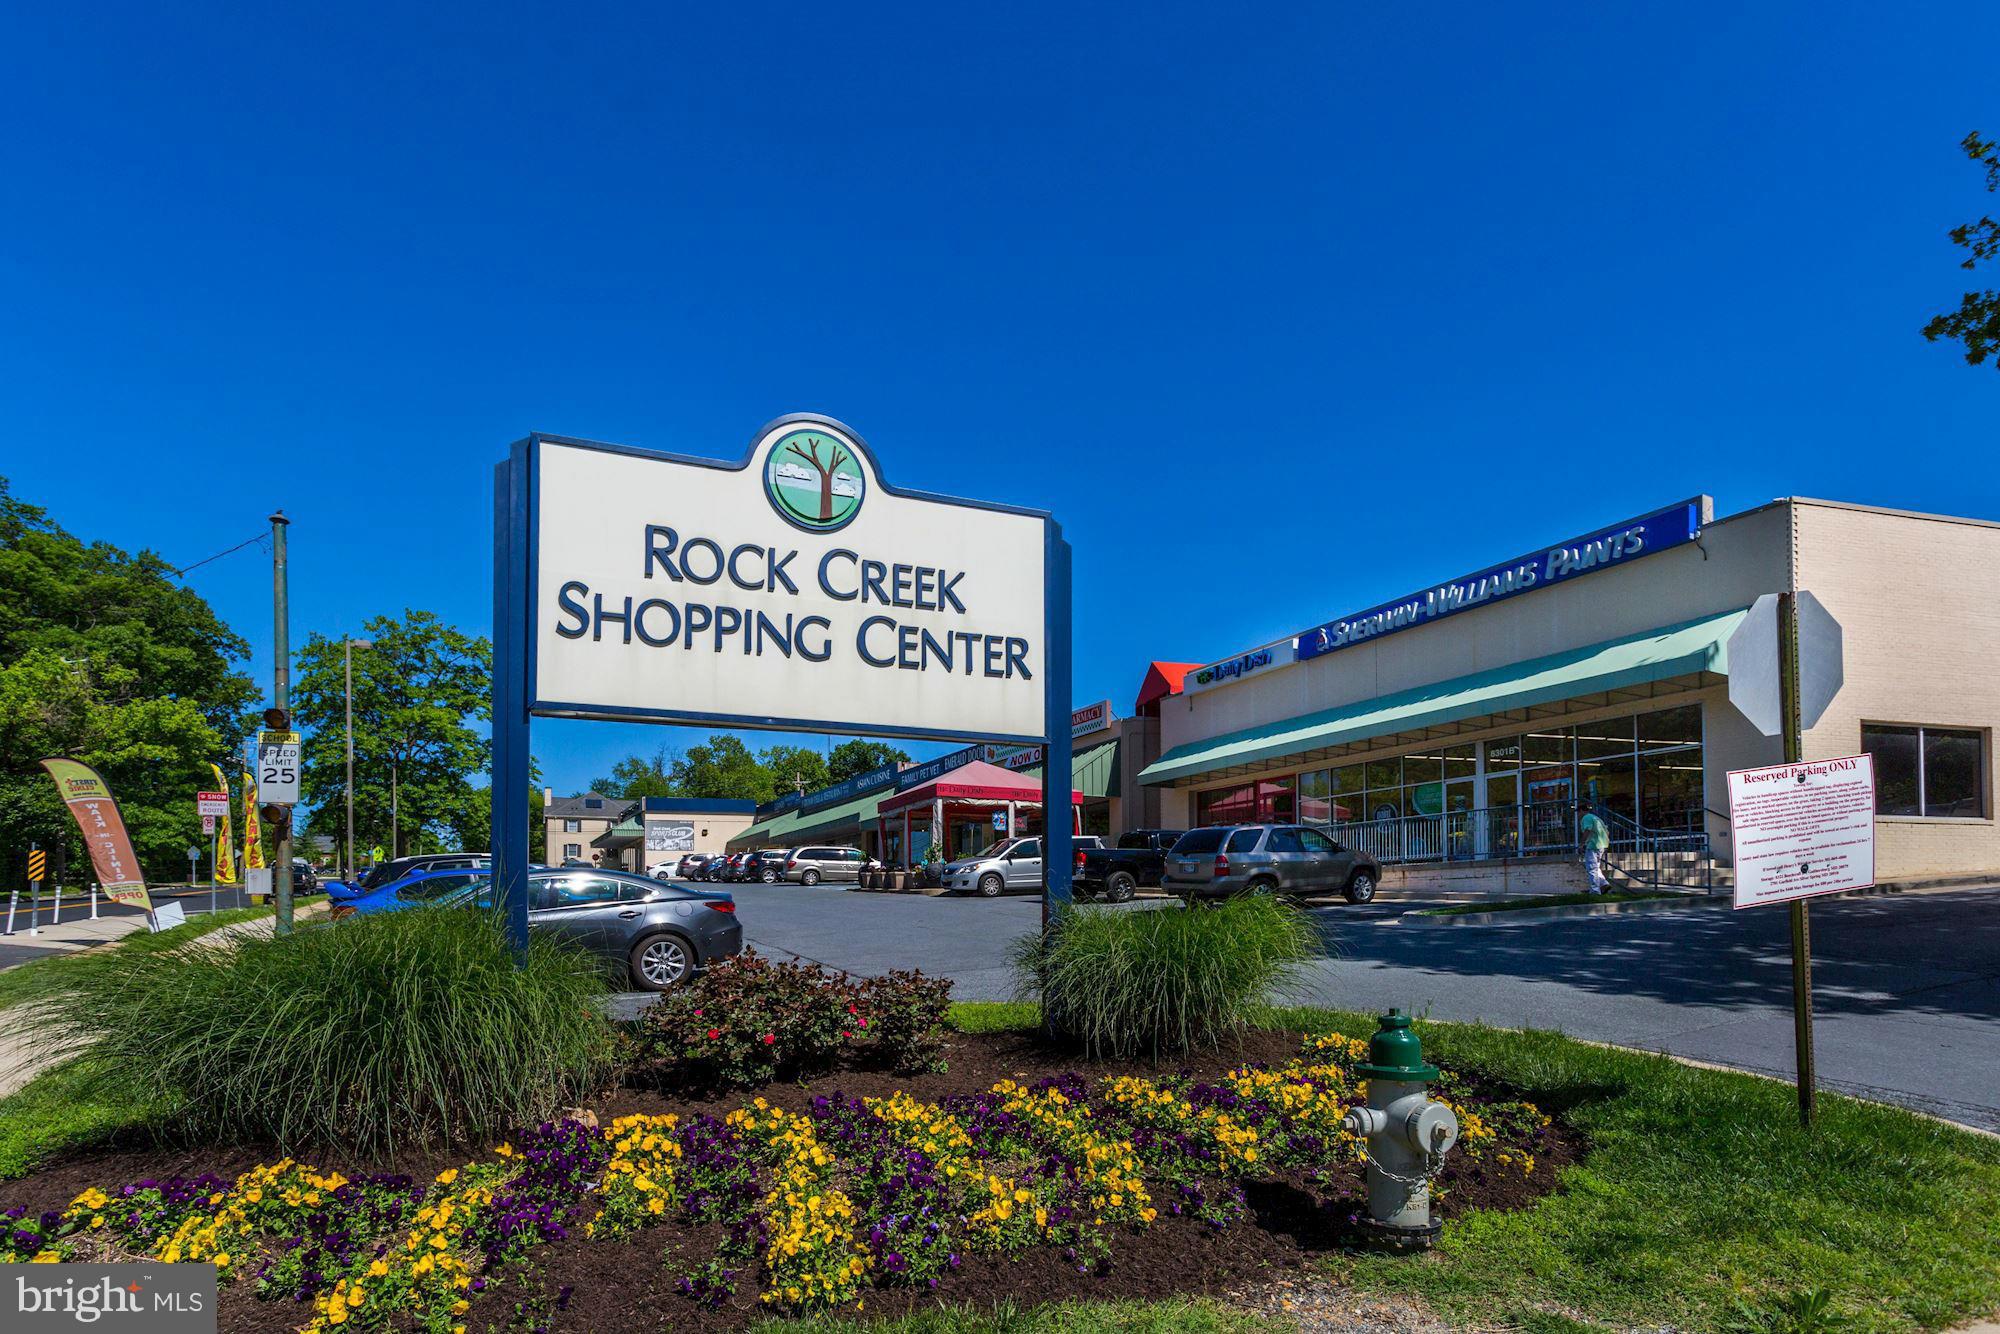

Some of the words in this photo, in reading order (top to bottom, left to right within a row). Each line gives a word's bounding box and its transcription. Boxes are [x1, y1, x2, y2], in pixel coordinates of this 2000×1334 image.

[644, 524, 799, 595] ROCK
[818, 549, 967, 614] CREEK
[1332, 561, 1538, 647] SHERWIN-WILLIAMS
[1544, 526, 1646, 579] PAINTS
[556, 581, 832, 662] SHOPPING
[856, 616, 1033, 680] CENTER
[1072, 706, 1101, 725] ARMACY
[261, 734, 298, 743] SCHOOL
[263, 749, 297, 757] SPEED
[265, 758, 292, 766] LIMIT
[1010, 752, 1031, 766] NOW
[263, 767, 295, 784] 25
[901, 772, 919, 786] FAMILY
[919, 767, 929, 780] PET
[929, 763, 940, 777] VET
[1744, 768, 1788, 784] Reserved
[1791, 762, 1828, 778] Parking
[1829, 760, 1858, 772] ONLY
